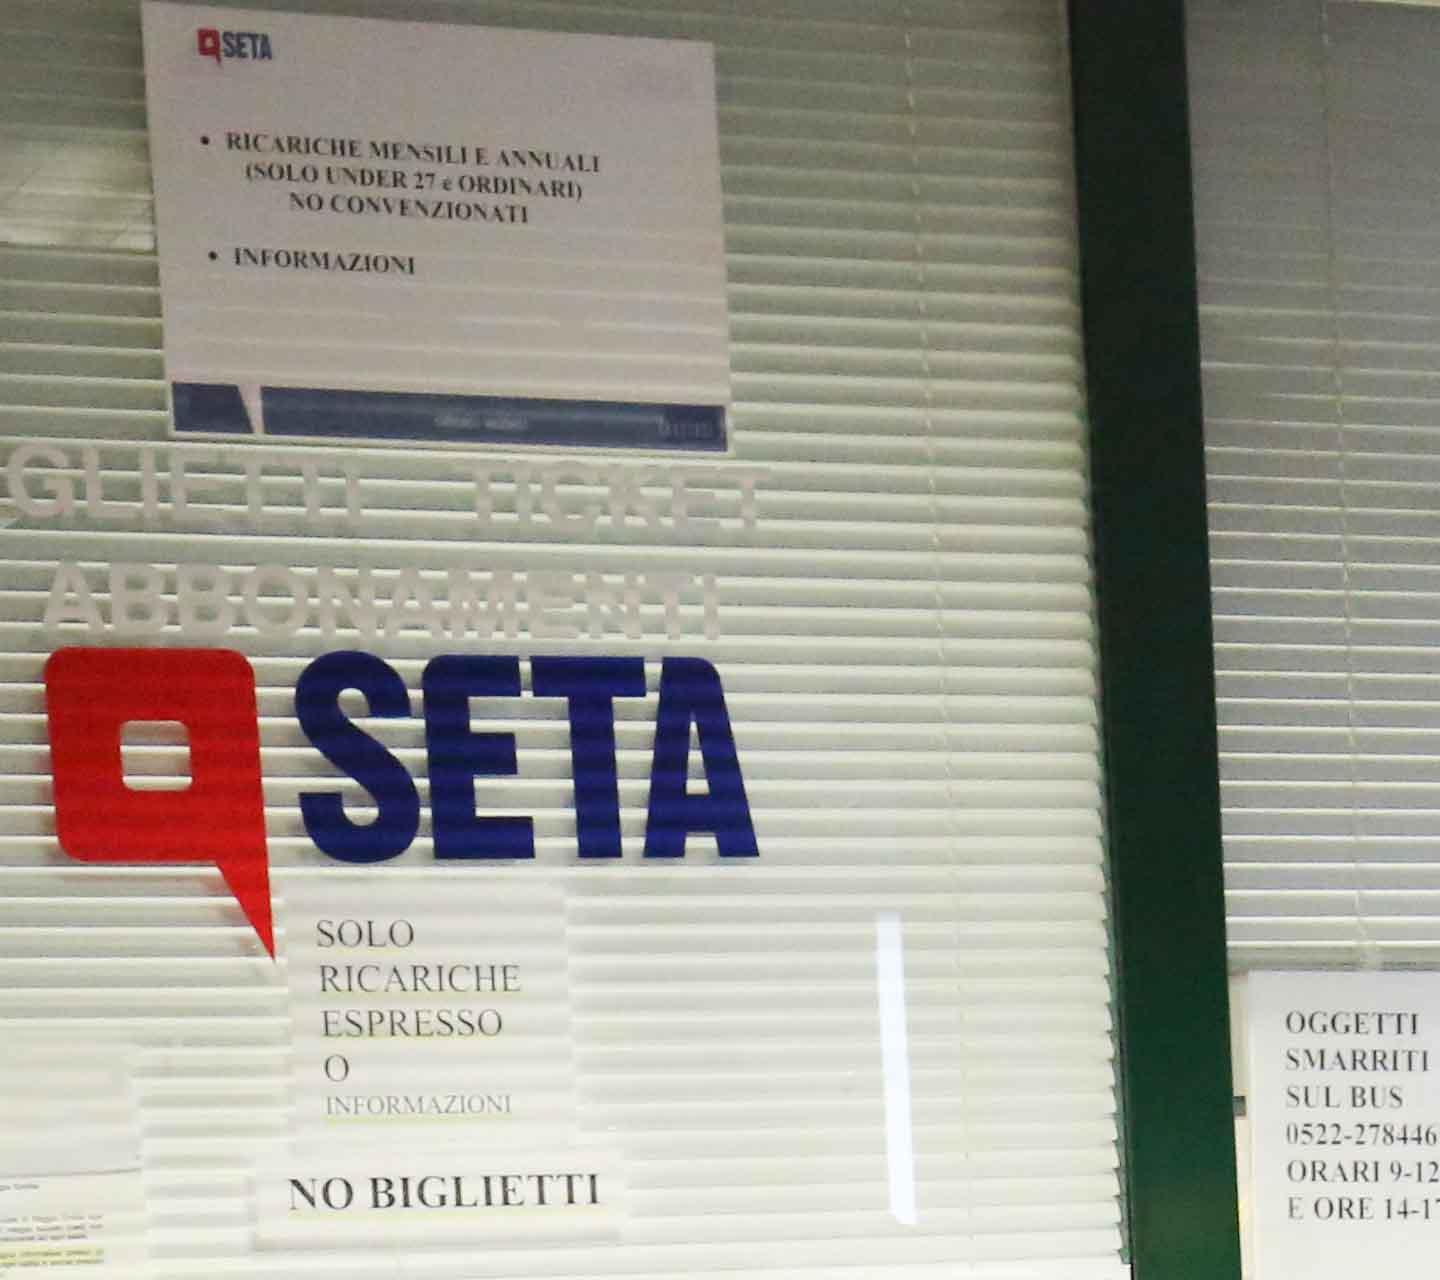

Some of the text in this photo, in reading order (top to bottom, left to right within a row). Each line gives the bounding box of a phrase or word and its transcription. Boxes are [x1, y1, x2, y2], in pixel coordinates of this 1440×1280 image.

[222, 32, 273, 61] SETA
[225, 131, 601, 174] RICARICHE MENSILI E ANNUALI
[245, 161, 319, 186] (SOLO
[327, 165, 409, 190] UNDER
[414, 170, 436, 191] 27
[458, 174, 583, 202] ORDINARI)
[289, 192, 530, 224] NO CONVENZIONATI
[234, 247, 416, 276] INFORMAZIONI
[465, 458, 770, 532] TICKET
[42, 560, 721, 641] ABBONAMENTI
[293, 649, 760, 864] SETA
[316, 918, 416, 950] SOLO
[318, 963, 523, 995] RICARICHE
[321, 1007, 504, 1039] ESPRESSO
[1285, 1011, 1420, 1036] OGGETTI
[324, 1052, 351, 1083] O
[1285, 1048, 1431, 1073] SMARRITI
[326, 1092, 513, 1118] INFORMAZIONI
[1286, 1085, 1404, 1109] SUL BUS
[1286, 1122, 1438, 1147] 0522-278446
[1287, 1159, 1440, 1184] ORARI 9-12
[287, 1171, 602, 1212] NO BIGLIETTI
[1288, 1198, 1304, 1220] E
[1313, 1197, 1375, 1221] ORE
